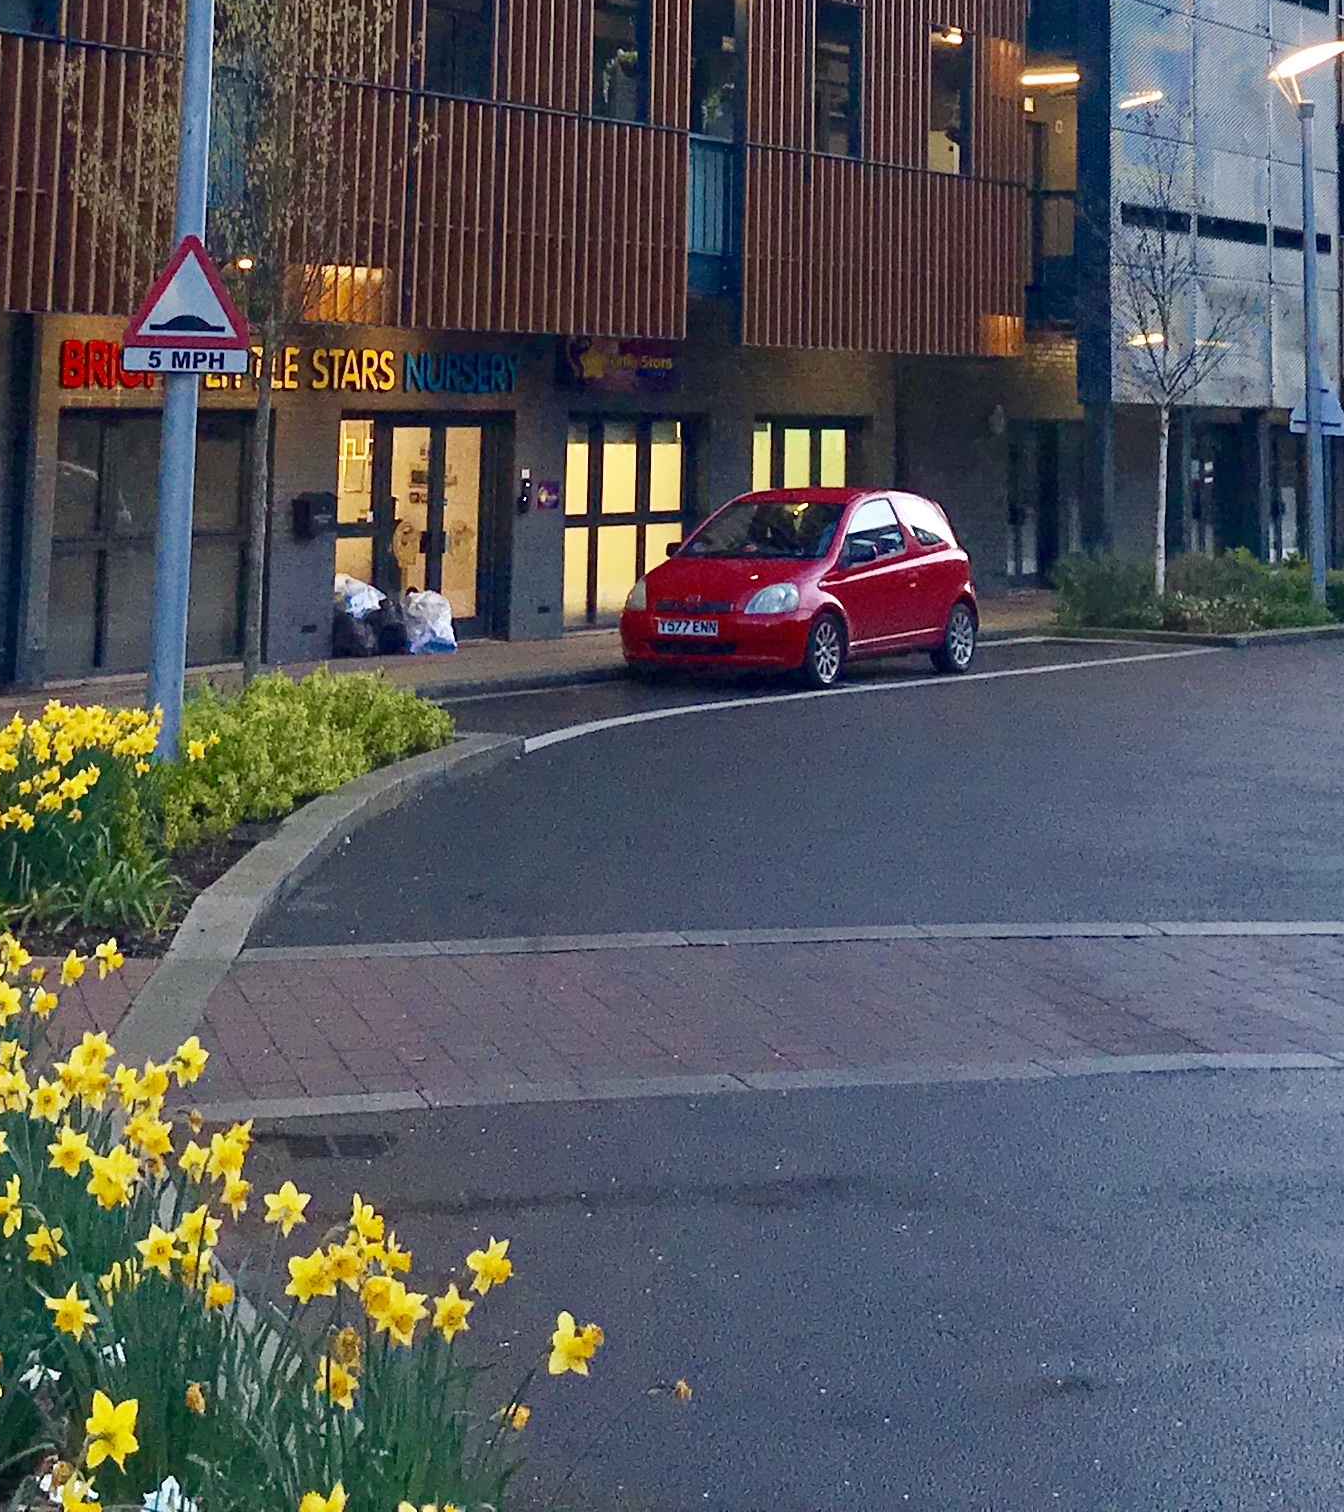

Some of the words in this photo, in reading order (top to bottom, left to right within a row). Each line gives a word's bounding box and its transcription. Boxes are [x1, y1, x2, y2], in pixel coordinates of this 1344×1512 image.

[60, 339, 154, 388] BRI
[205, 346, 301, 390] TLE
[311, 348, 396, 392] STARS
[404, 352, 521, 392] NURSERY
[147, 350, 162, 369] 5
[171, 351, 226, 370] MPH
[659, 620, 691, 634] Y577
[691, 621, 717, 634] ENN
